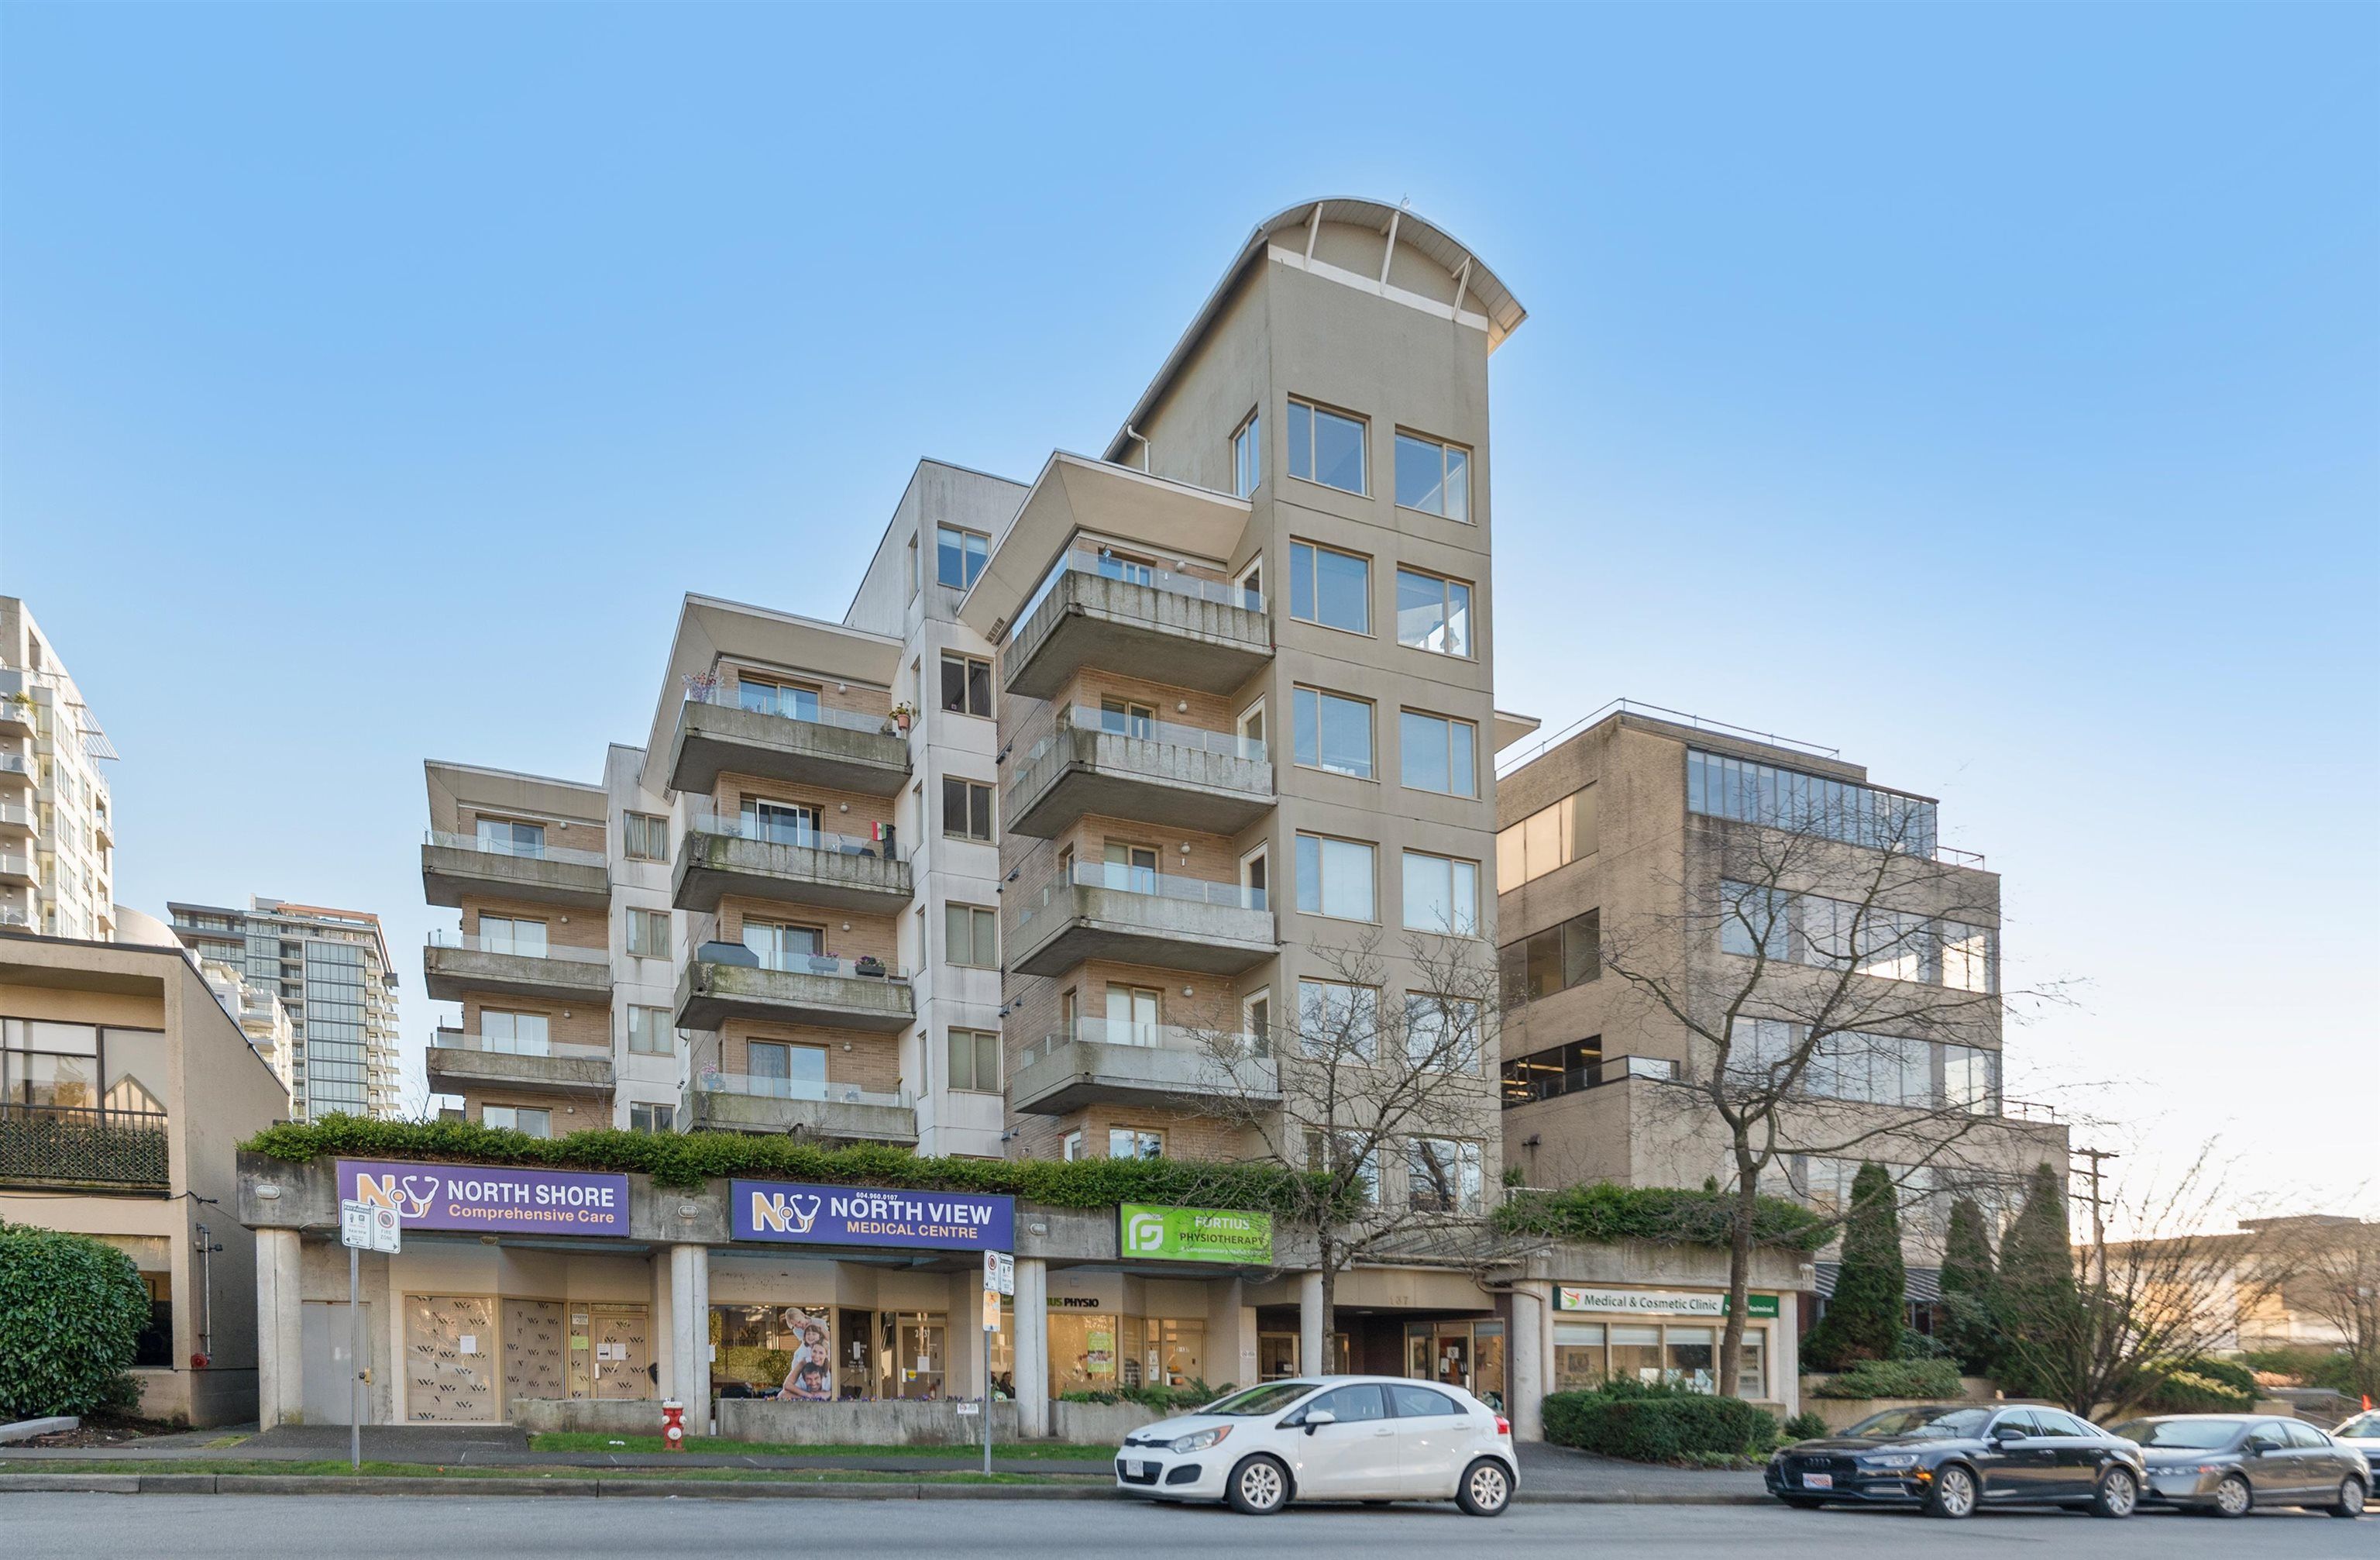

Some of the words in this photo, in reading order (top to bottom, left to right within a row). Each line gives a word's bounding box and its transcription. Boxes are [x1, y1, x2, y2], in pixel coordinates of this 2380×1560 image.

[447, 1180, 530, 1204] NORTH
[535, 1185, 614, 1207] SHORE
[855, 1192, 898, 1200] 604.960.0107
[449, 1204, 574, 1221] Comprehensive
[578, 1210, 615, 1224] Care
[831, 1197, 923, 1221] NORTH
[927, 1202, 992, 1225] VIEW
[847, 1221, 915, 1236] MEDICAL
[918, 1224, 978, 1238] CENTRE
[1195, 1217, 1250, 1230] FORTIUS
[1179, 1232, 1264, 1245] PHYSIOTHERAPY
[1064, 1297, 1099, 1308] PHYSIO
[1584, 1294, 1626, 1307] Medical
[1629, 1297, 1637, 1308] &
[1639, 1297, 1687, 1310] Cosmetic
[1690, 1297, 1718, 1310] Clinic
